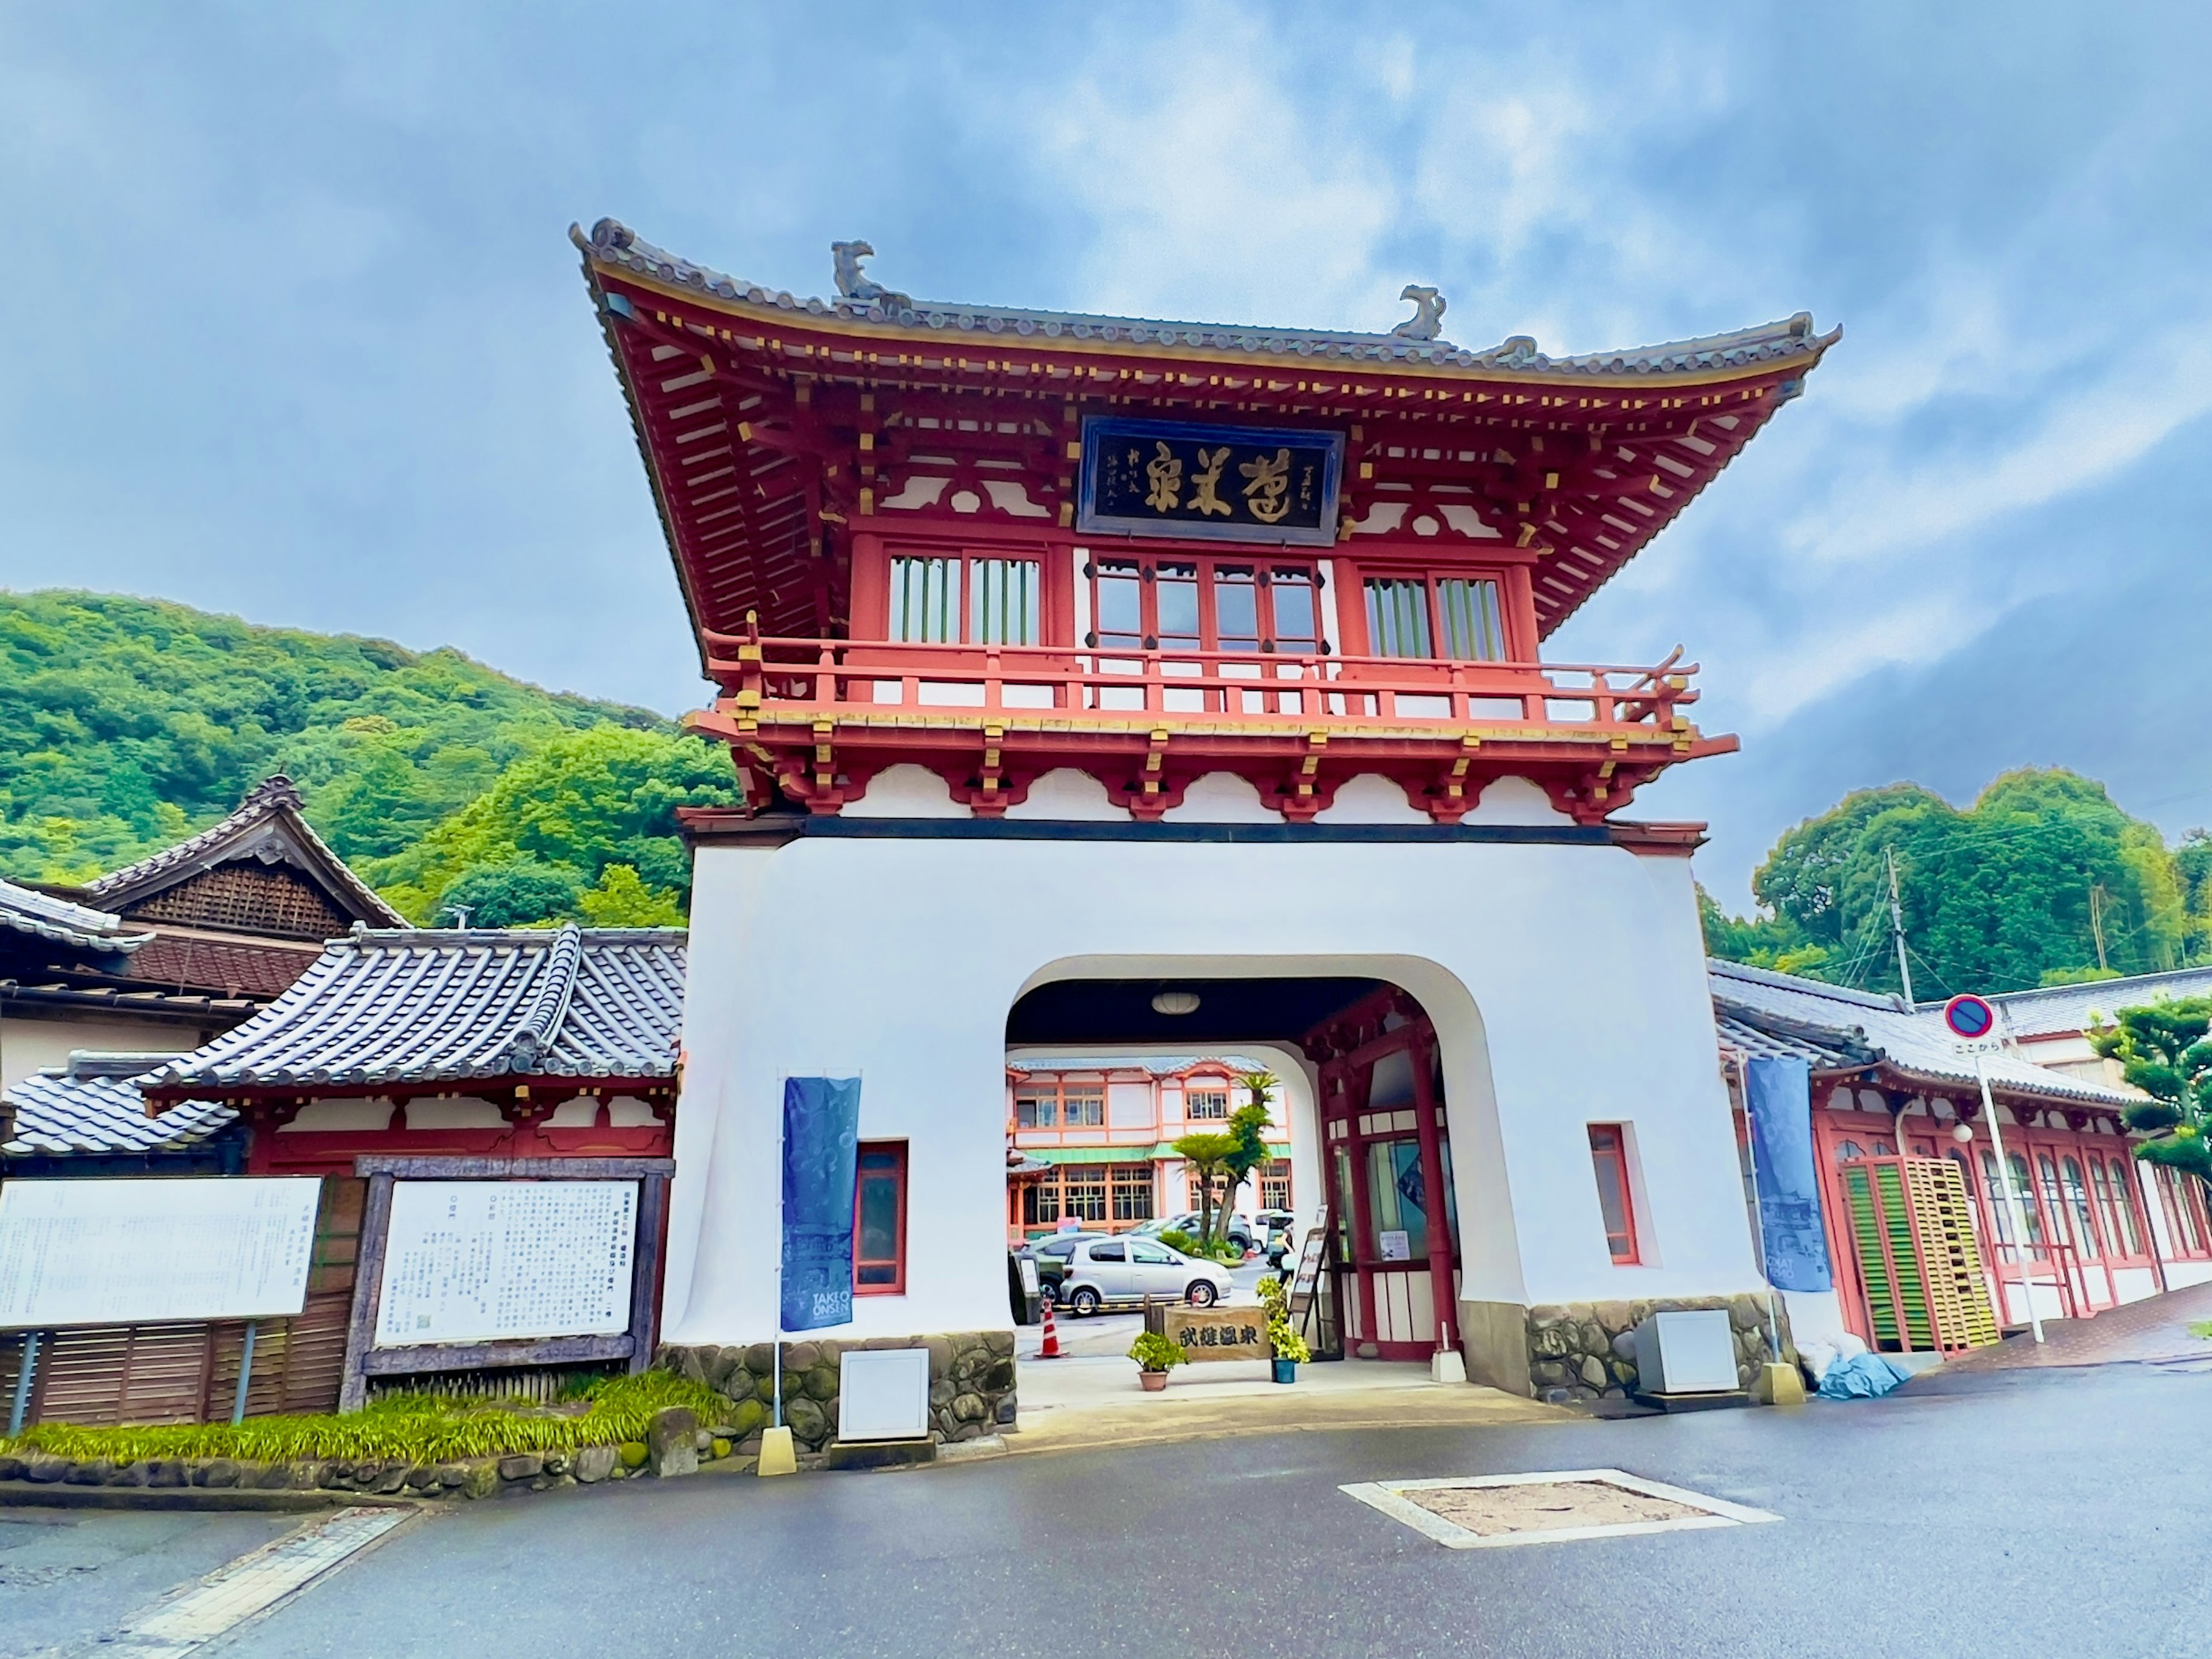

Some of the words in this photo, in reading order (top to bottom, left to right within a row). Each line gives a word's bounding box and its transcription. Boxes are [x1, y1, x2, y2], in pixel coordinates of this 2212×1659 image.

[1956, 1041, 1999, 1054] ここから
[812, 1291, 850, 1305] TAKEO
[813, 1302, 849, 1316] ONSEN
[1180, 1324, 1259, 1347] 武雄温泉
